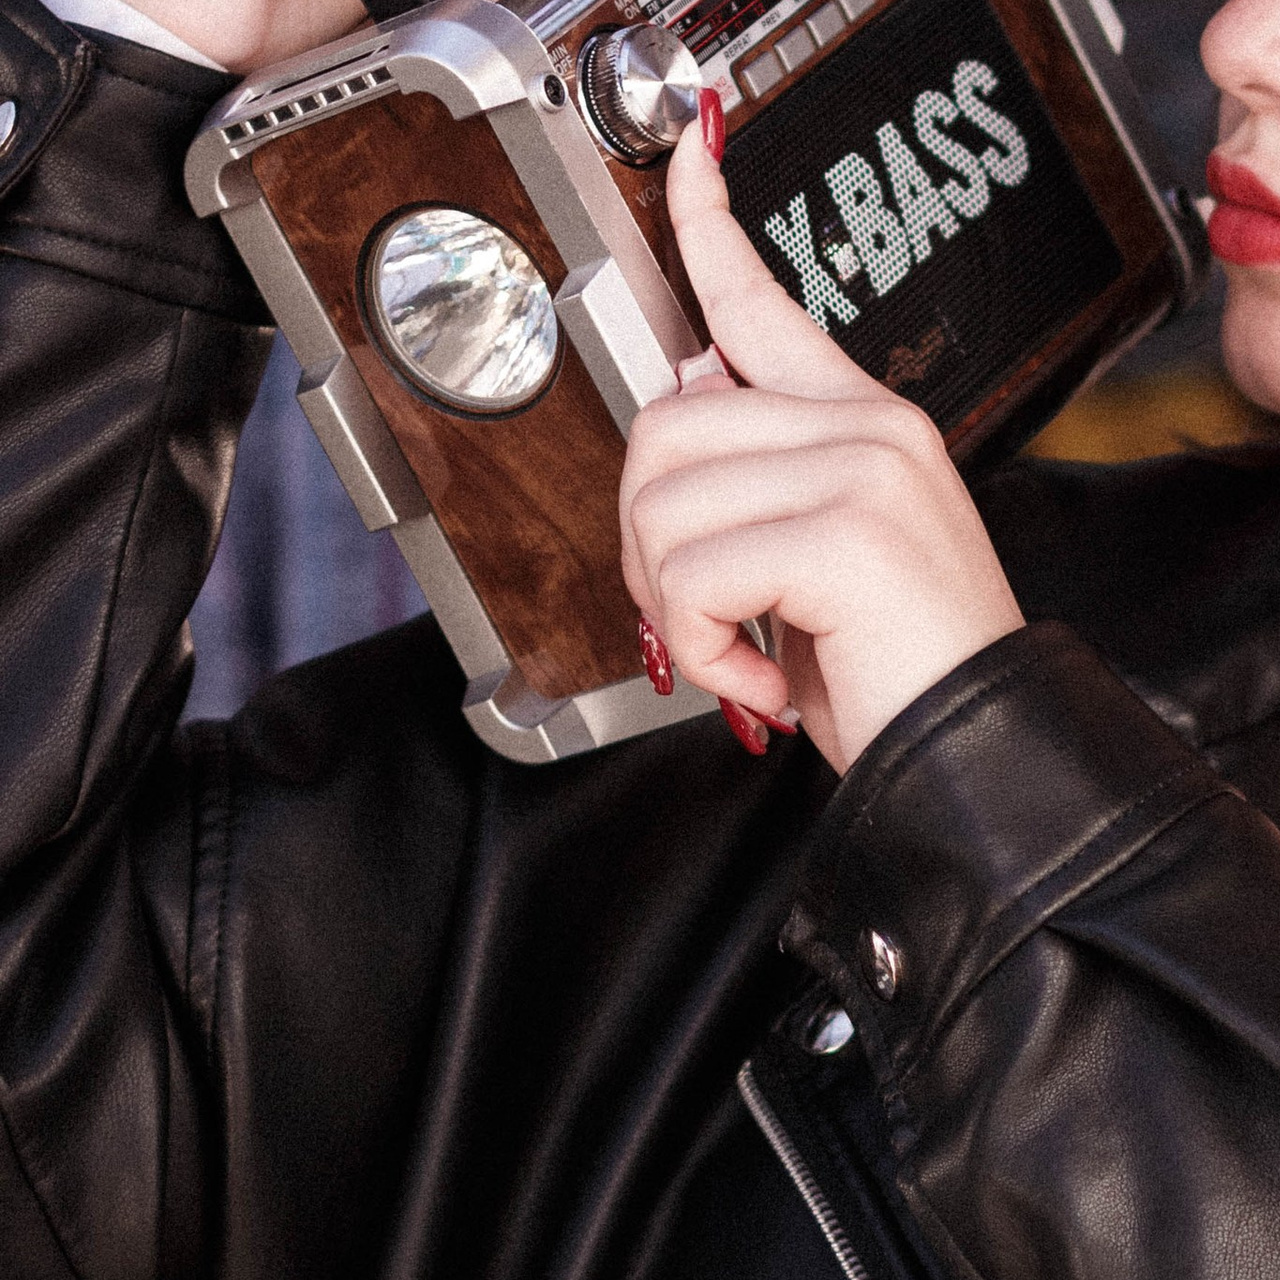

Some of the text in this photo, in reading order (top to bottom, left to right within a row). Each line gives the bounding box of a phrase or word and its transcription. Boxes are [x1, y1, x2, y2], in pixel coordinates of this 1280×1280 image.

[623, 1, 641, 21] ON
[728, 0, 739, 12] 4
[760, 9, 780, 30] PREV
[548, 42, 569, 64] MIN
[723, 32, 752, 61] REPEAT
[554, 54, 575, 76] OFF
[765, 60, 1030, 331] X-BASS
